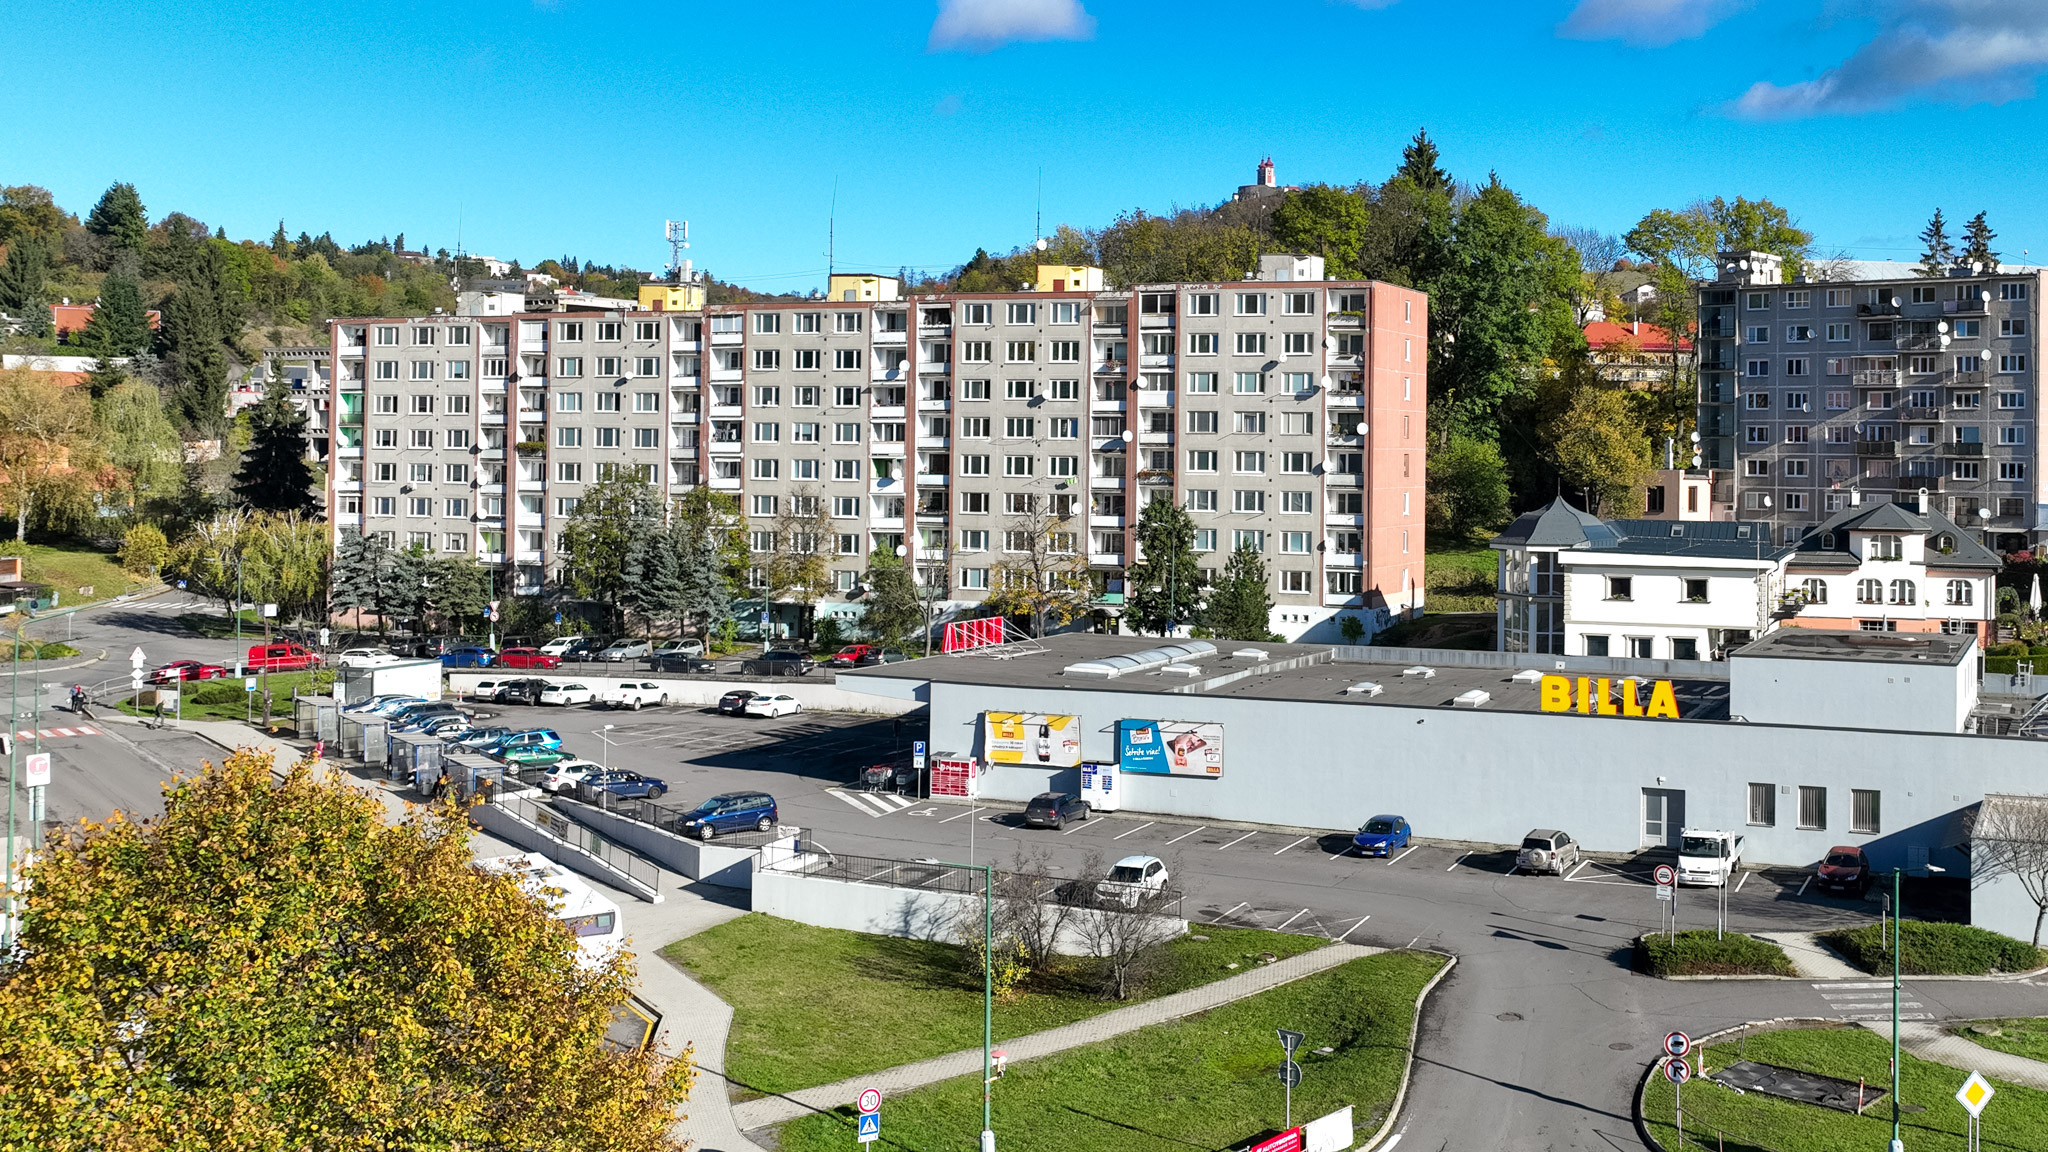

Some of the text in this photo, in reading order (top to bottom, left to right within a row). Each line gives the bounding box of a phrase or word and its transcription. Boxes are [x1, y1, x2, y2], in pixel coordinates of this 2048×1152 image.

[1540, 675, 1680, 718] BILLA
[916, 743, 922, 752] P
[864, 1095, 877, 1107] 30
